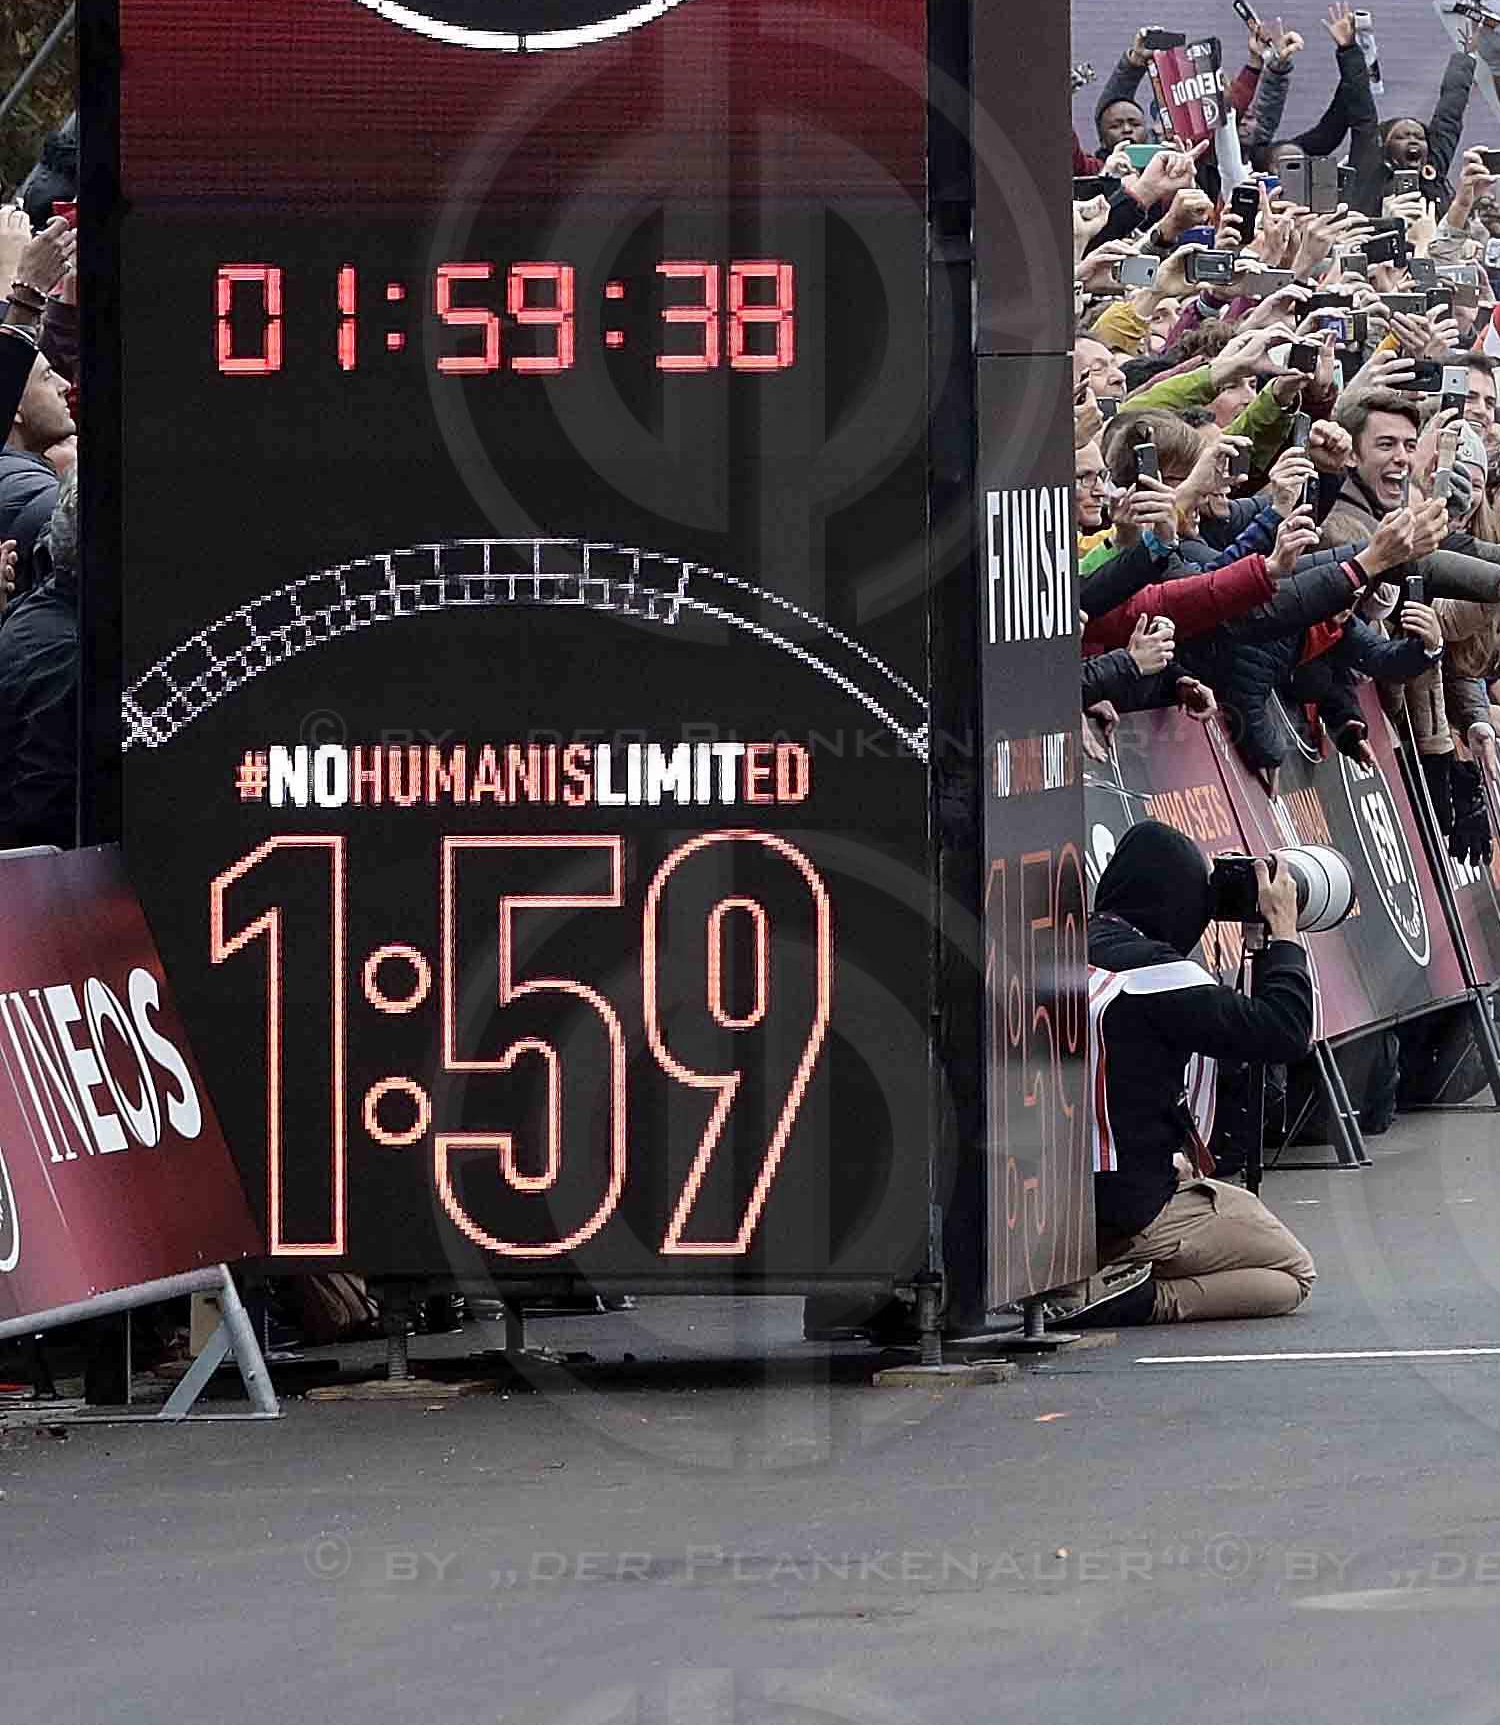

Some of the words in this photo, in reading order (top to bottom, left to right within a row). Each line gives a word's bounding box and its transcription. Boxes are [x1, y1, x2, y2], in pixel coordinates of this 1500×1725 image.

[213, 261, 797, 376] 01:59:38
[986, 485, 1073, 644] FINISH
[234, 741, 811, 807] #NOHUMANISLIMITED
[0, 966, 202, 1164] INEOS
[210, 827, 836, 1258] 1:59
